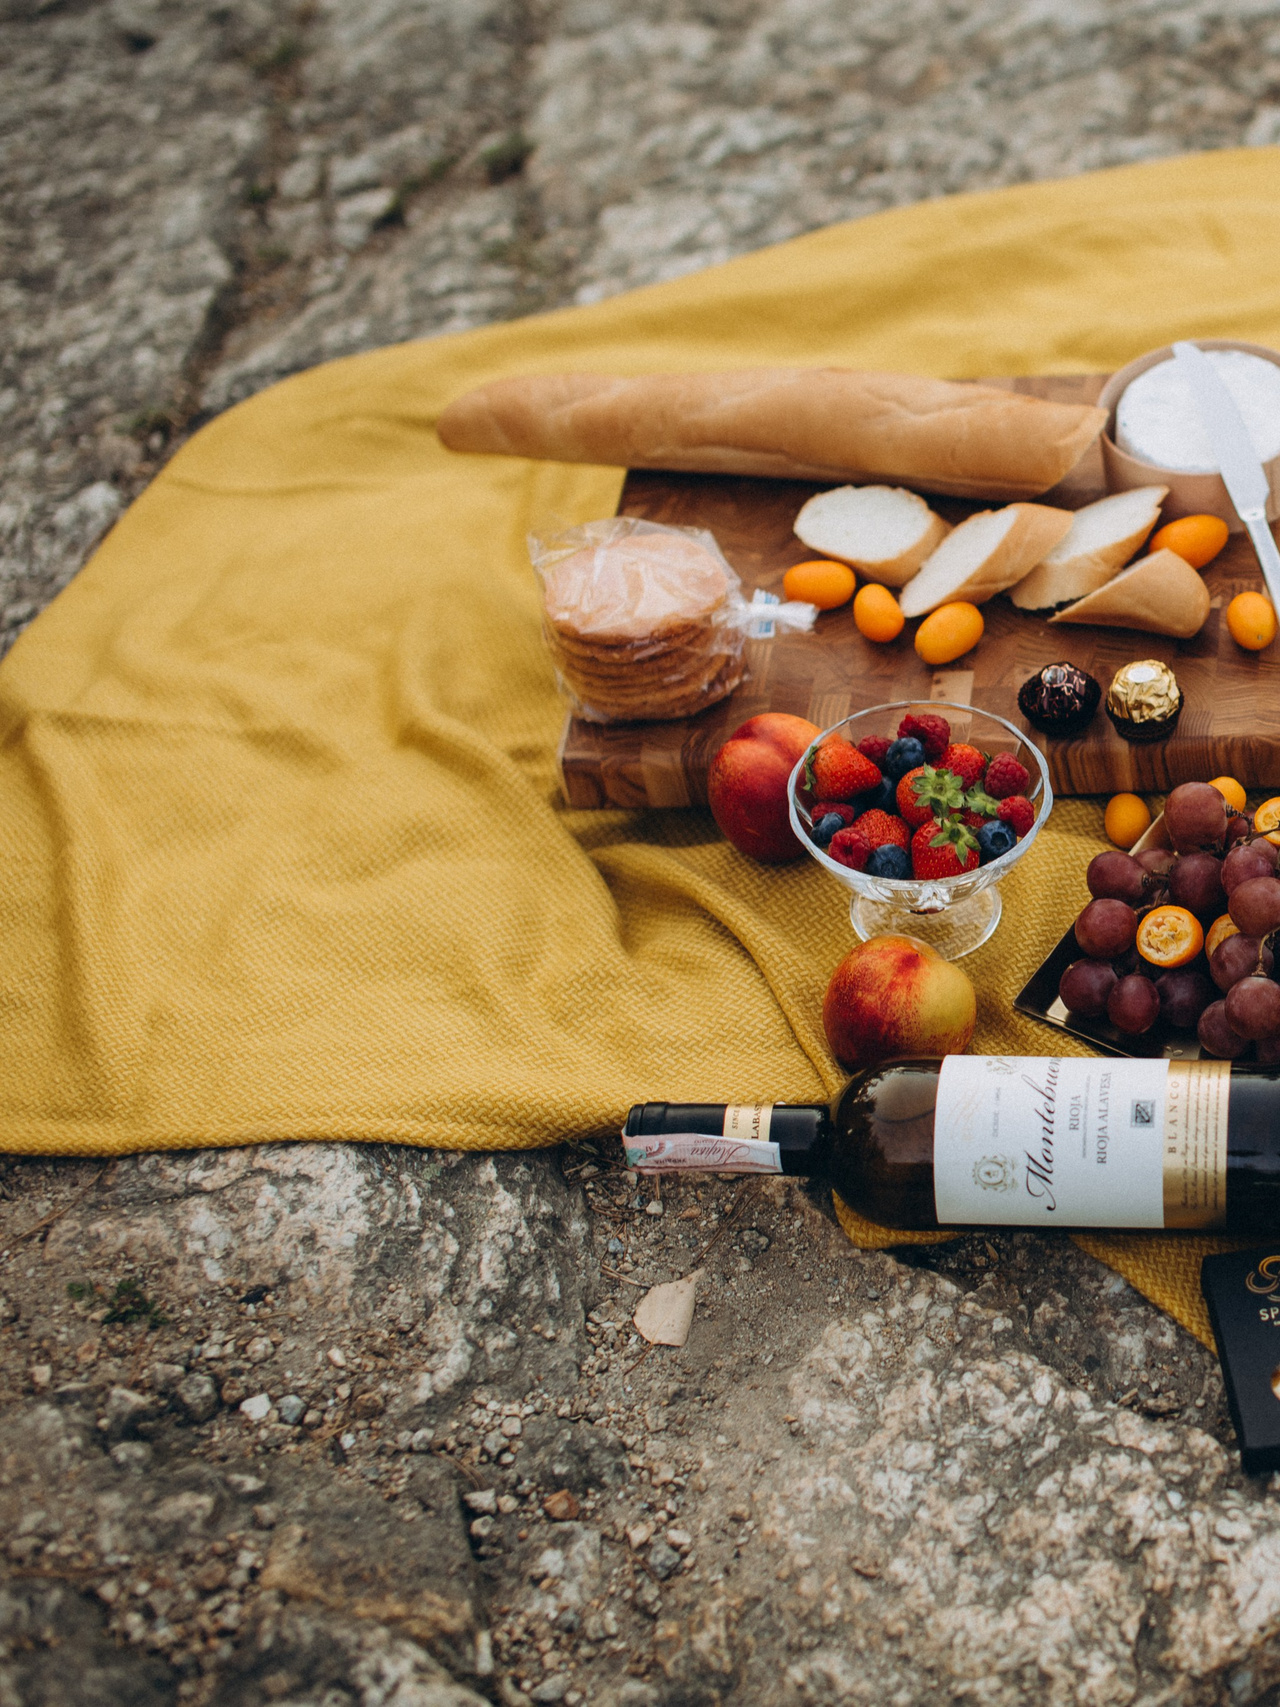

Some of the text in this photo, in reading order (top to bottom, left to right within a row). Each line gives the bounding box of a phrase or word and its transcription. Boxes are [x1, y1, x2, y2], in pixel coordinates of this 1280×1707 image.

[1069, 1094, 1082, 1131] RIOJA
[1097, 1071, 1112, 1165] RIOJA ALAVESA
[1167, 1080, 1180, 1154] BLANCO
[690, 1139, 750, 1166] Марка
